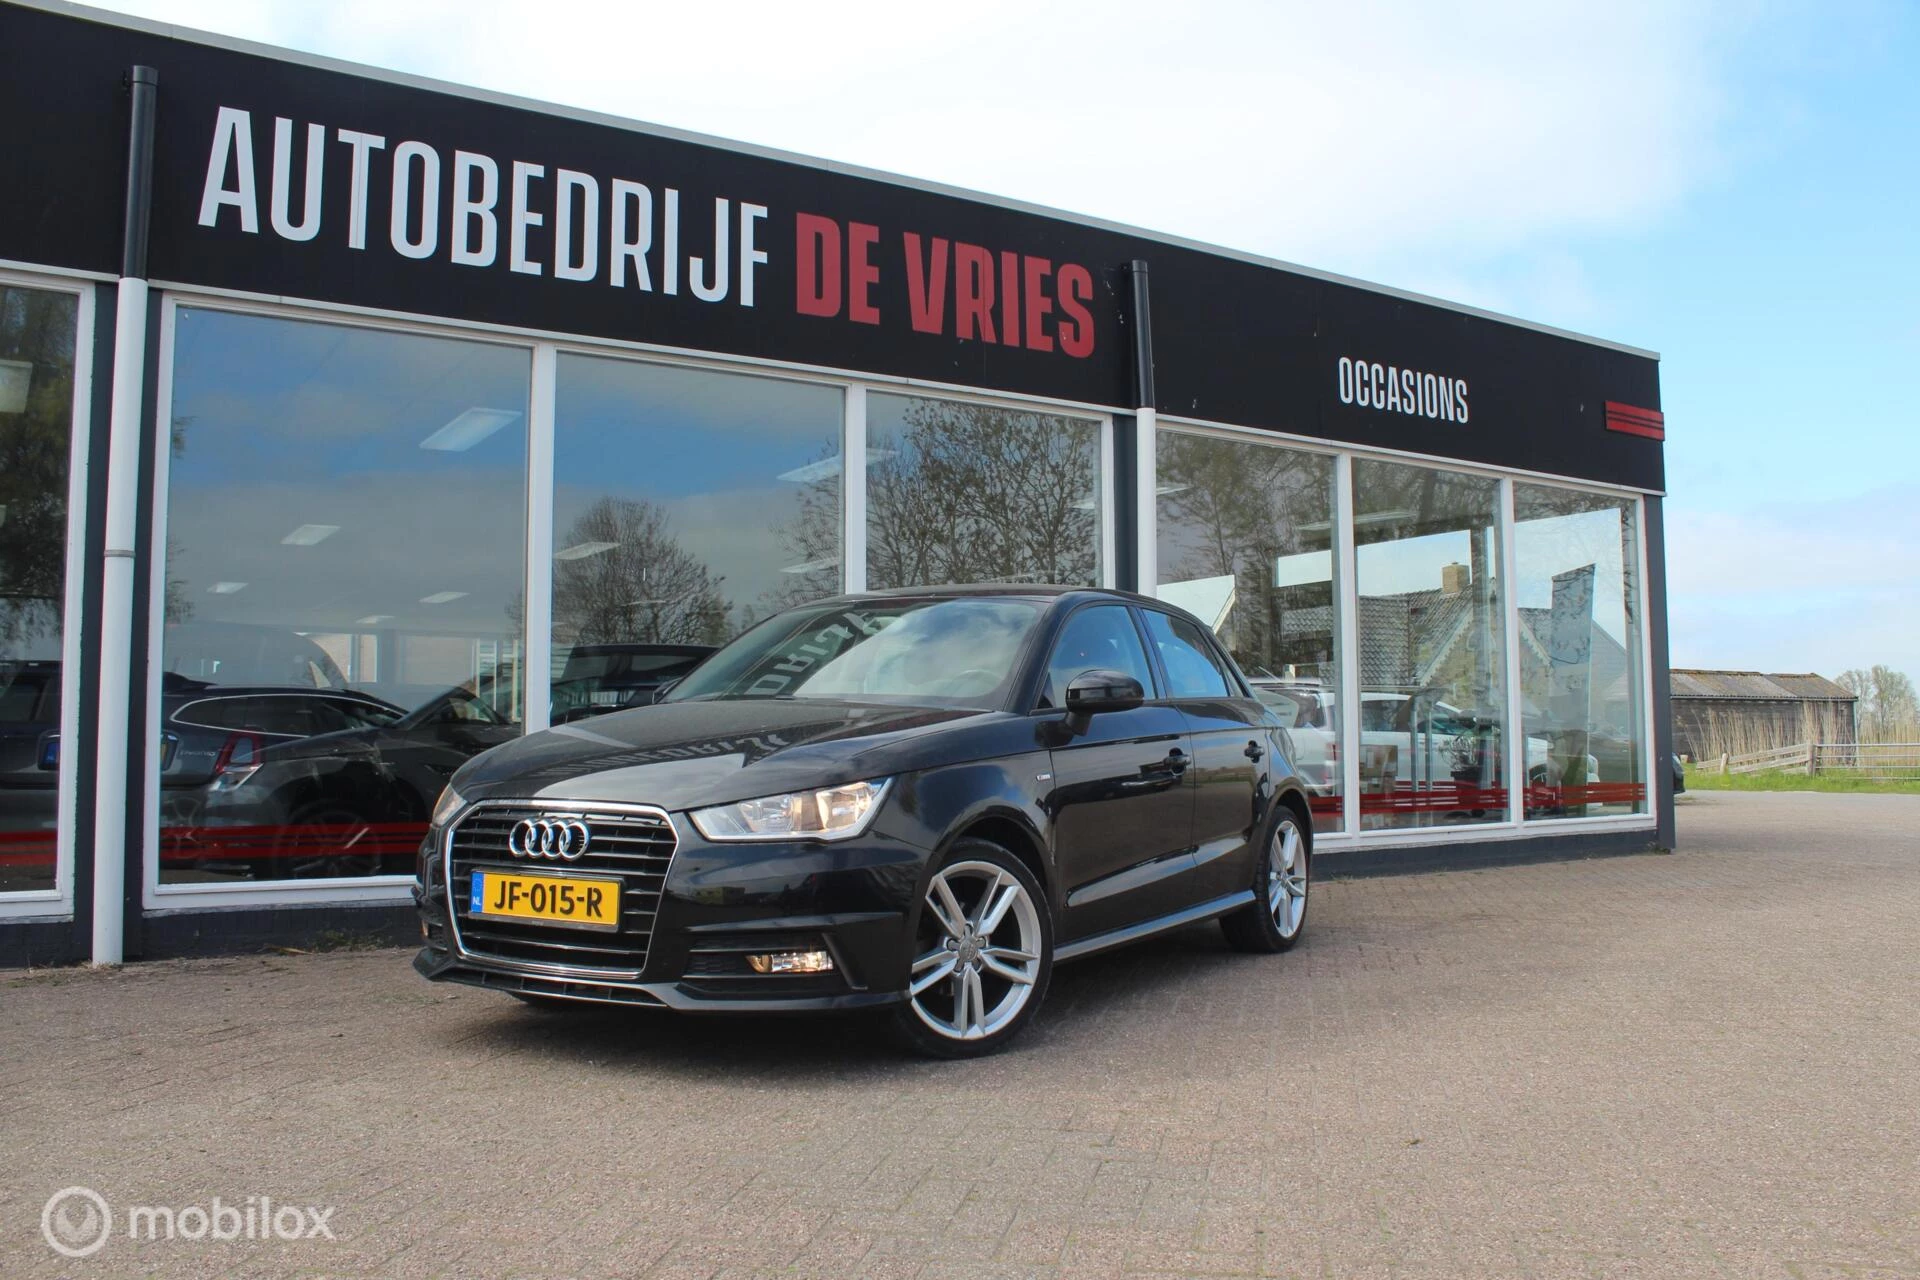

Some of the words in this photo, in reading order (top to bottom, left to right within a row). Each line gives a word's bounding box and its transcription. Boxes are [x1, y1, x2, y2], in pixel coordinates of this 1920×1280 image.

[198, 106, 768, 308] AUTOBEDRIJF
[797, 213, 880, 324] DE
[904, 232, 1095, 358] VRIES
[1338, 356, 1469, 424] OCCASIONS
[472, 896, 481, 905] NL
[494, 880, 603, 918] JF-015-R
